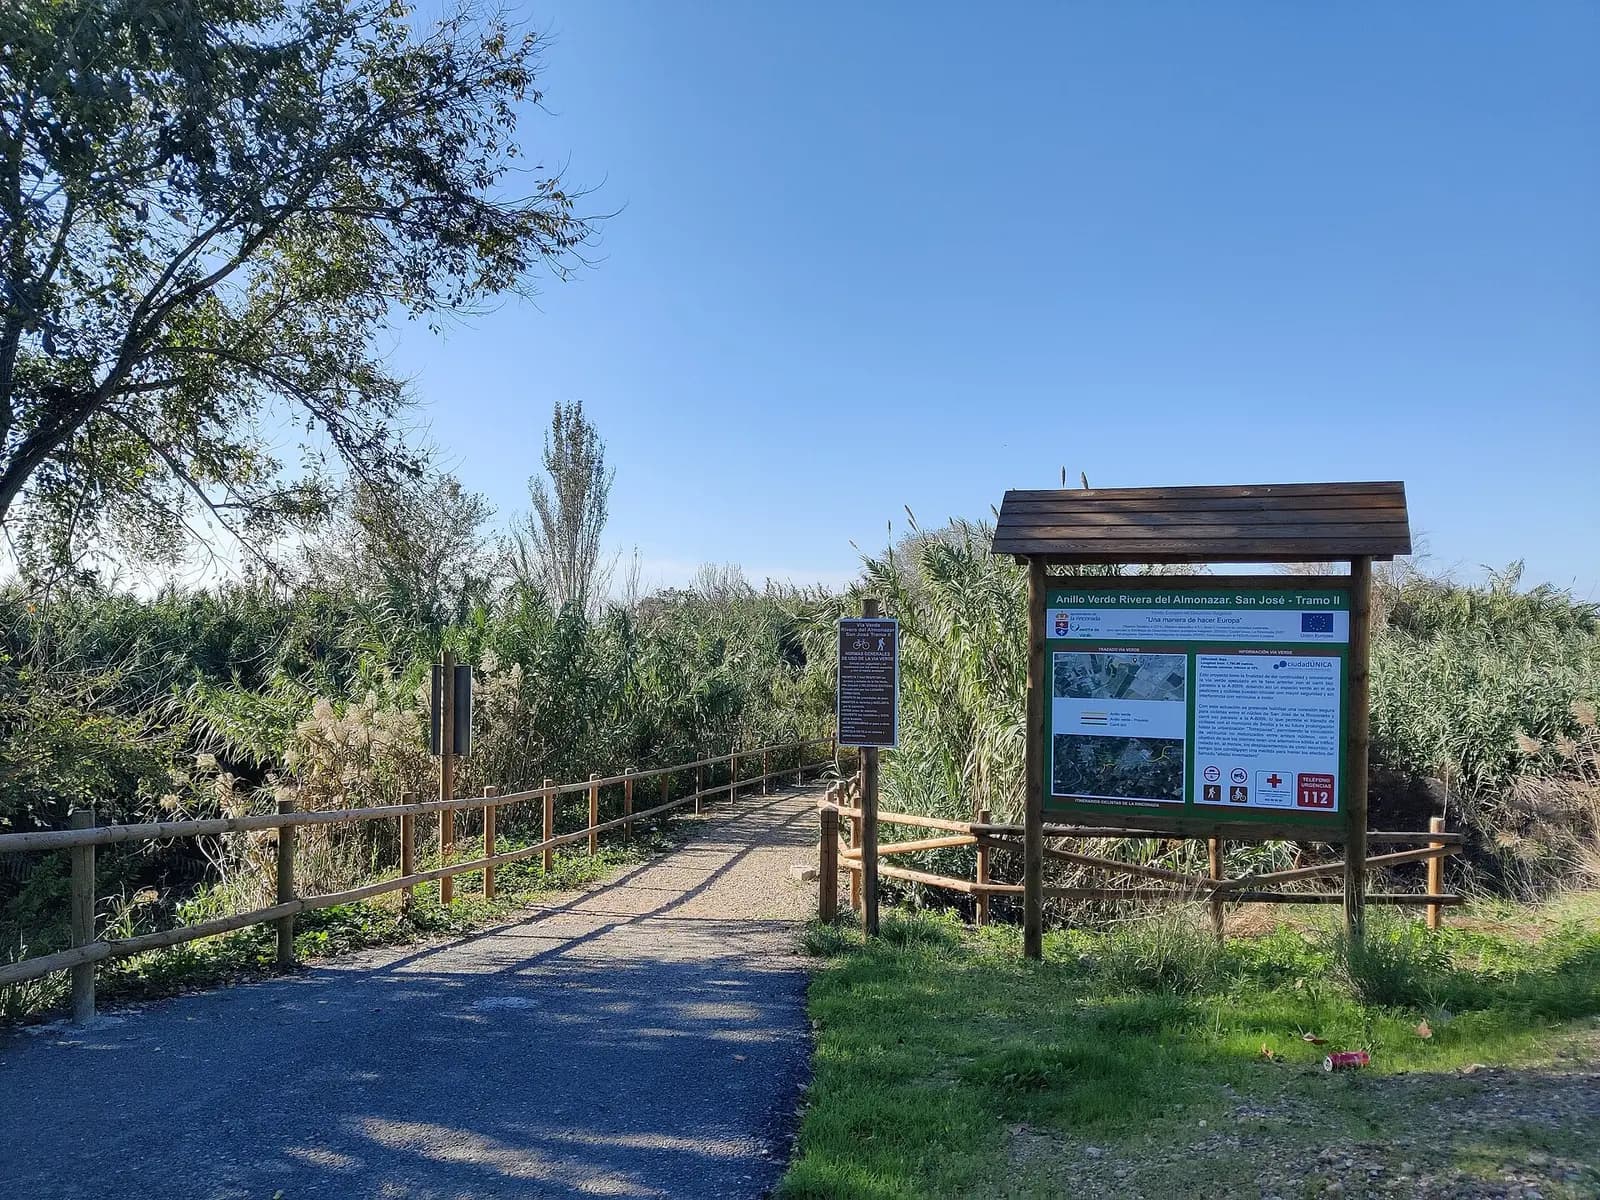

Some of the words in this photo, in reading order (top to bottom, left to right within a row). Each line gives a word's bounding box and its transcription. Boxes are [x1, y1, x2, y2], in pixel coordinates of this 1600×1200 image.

[1056, 595, 1085, 604] Anillo
[1088, 595, 1116, 604] Verde
[1120, 595, 1152, 604] Rivera
[1155, 595, 1170, 604] del
[1173, 595, 1232, 604] Almonazar.
[1235, 596, 1256, 605] San
[1259, 596, 1285, 605] José
[1296, 596, 1330, 605] Tramo
[1334, 596, 1340, 605] II
[1304, 791, 1328, 804] 112
